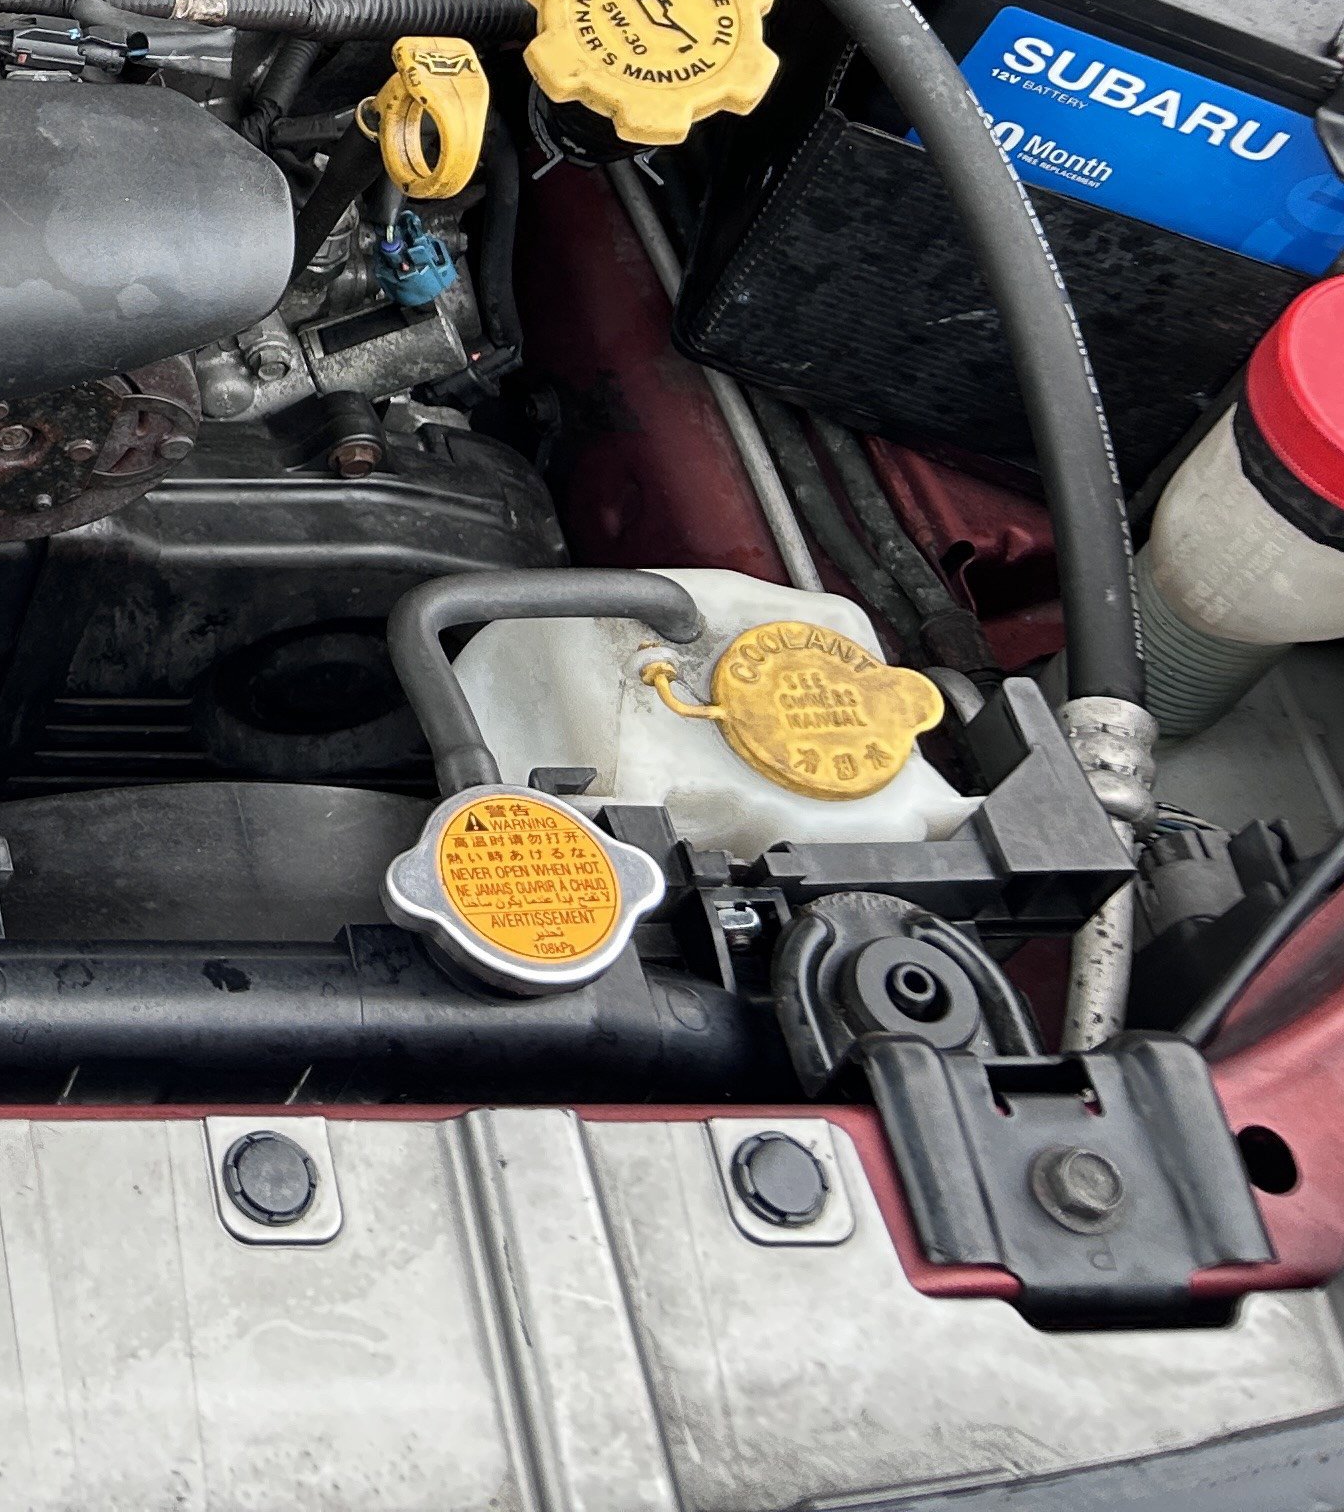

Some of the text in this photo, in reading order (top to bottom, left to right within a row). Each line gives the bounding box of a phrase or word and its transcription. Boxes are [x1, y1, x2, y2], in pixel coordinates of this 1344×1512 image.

[601, 0, 648, 57] 5W-30
[712, 16, 734, 48] OIL
[622, 56, 716, 84] MANUAL
[990, 67, 1089, 111] 12V BATTERY
[1002, 35, 1291, 163] SUBARU
[1023, 134, 1113, 182] Month
[729, 625, 877, 684] COOLANT
[781, 671, 824, 691] SEE
[785, 708, 868, 729] MANUAL
[484, 803, 531, 818] 警告
[489, 817, 558, 831] WARNING
[450, 861, 604, 881] NEVER OPEN WHEN HOT.
[456, 883, 470, 897] NE
[474, 882, 513, 897] JAMAIS
[516, 880, 555, 895] OUVRIR
[491, 909, 597, 929] AVERTISSEMENT
